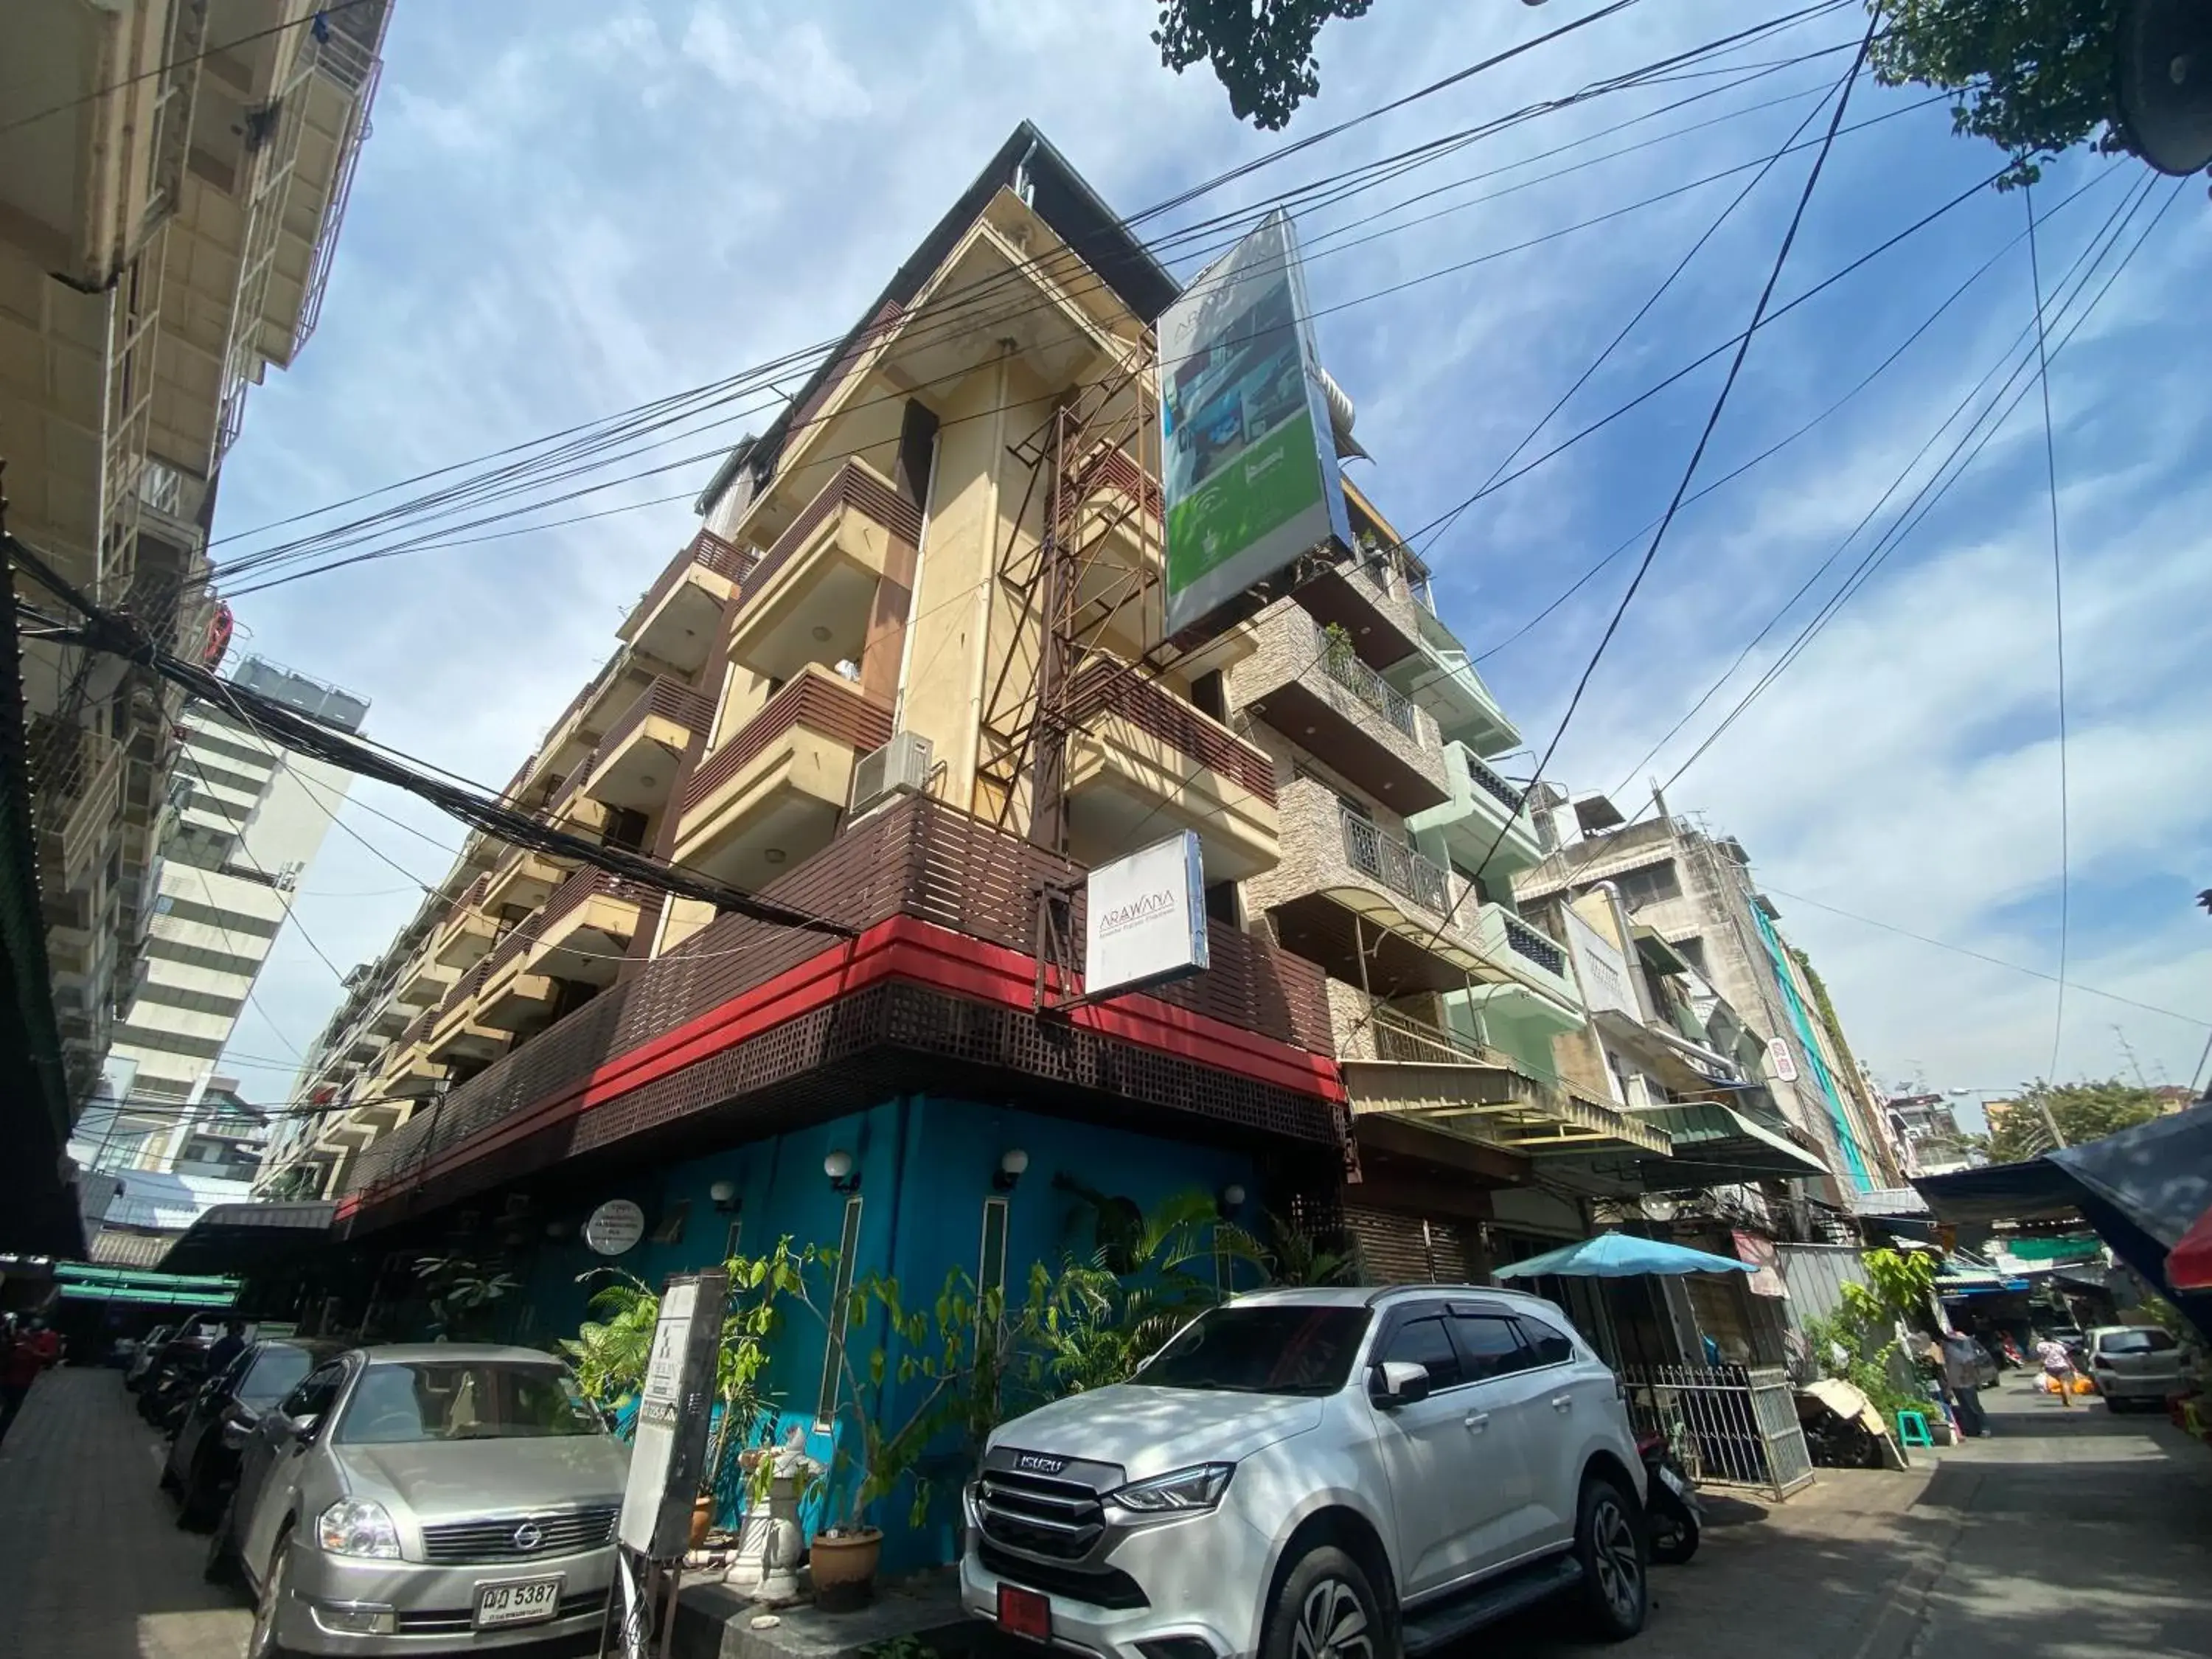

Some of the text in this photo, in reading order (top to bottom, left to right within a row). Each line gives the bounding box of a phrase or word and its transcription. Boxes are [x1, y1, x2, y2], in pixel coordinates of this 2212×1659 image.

[1099, 889, 1175, 931] ARAWANA
[1021, 1456, 1062, 1472] ISUZU
[514, 1585, 555, 1605] 5387
